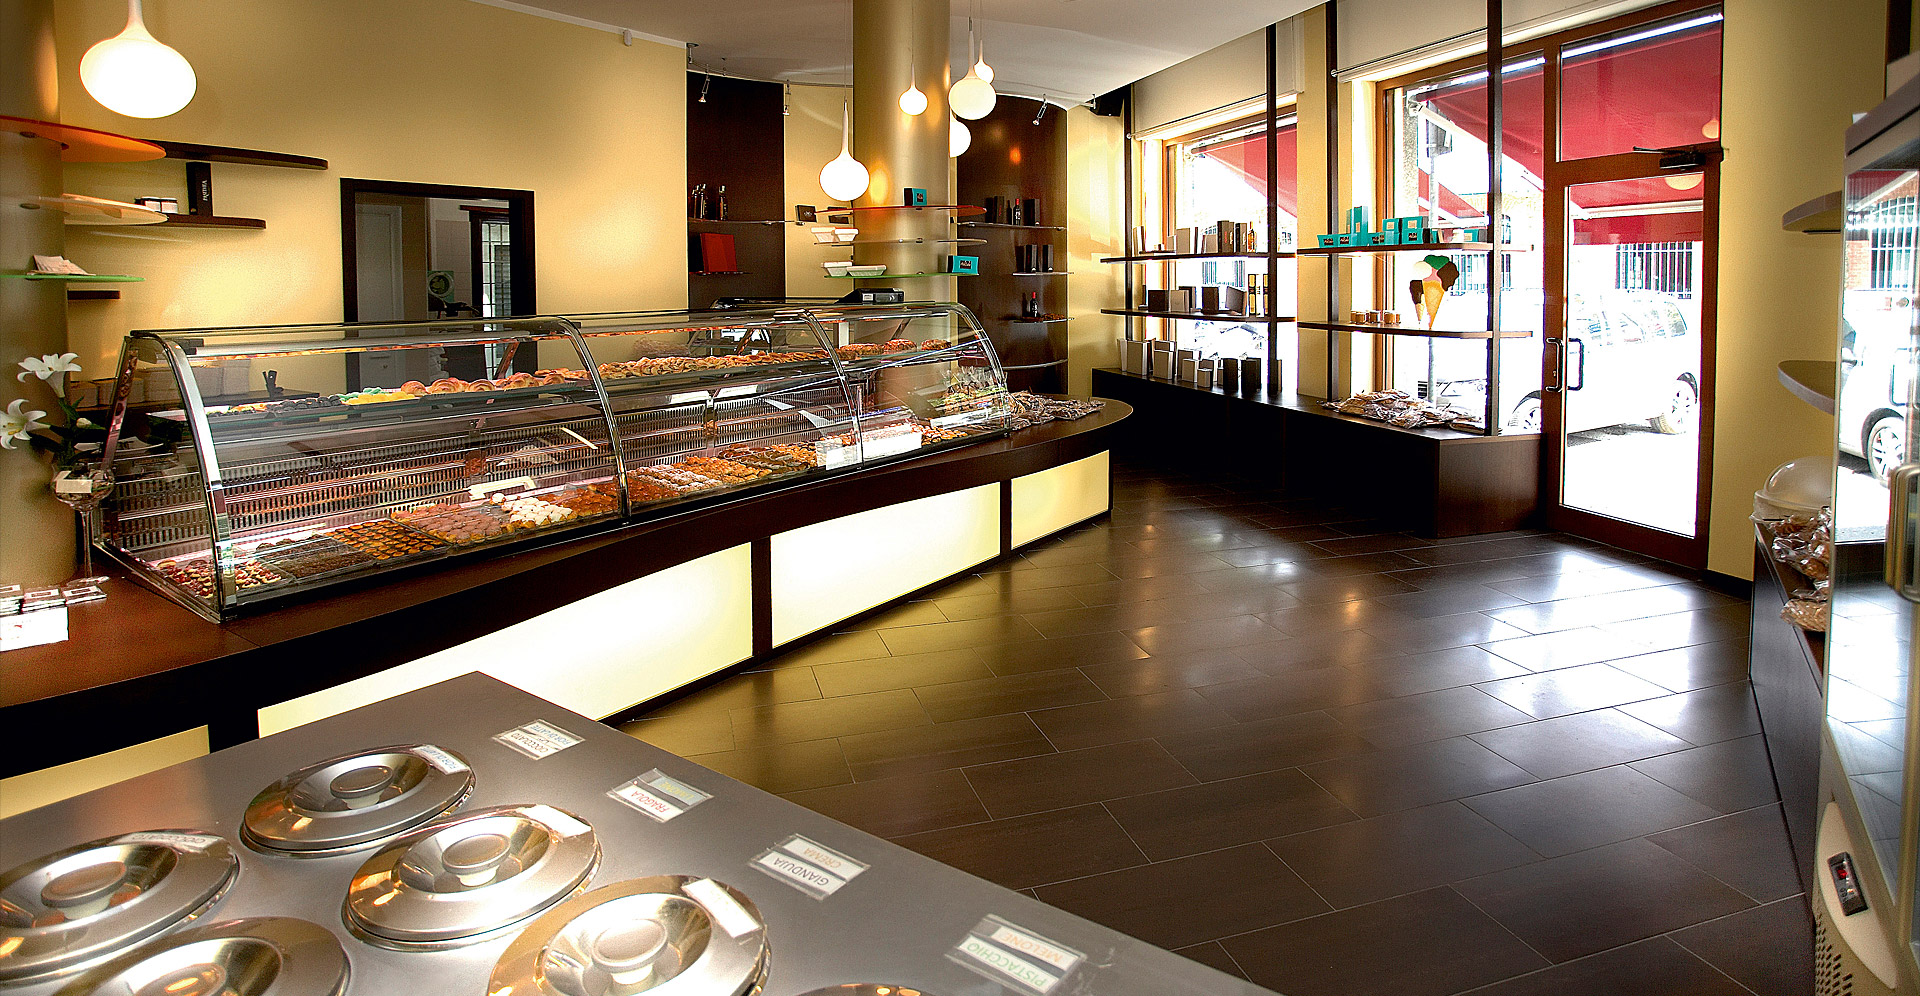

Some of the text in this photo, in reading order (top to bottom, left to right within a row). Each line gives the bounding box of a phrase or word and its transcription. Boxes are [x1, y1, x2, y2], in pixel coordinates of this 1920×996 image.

[631, 790, 670, 813] FRAGOLA
[773, 857, 829, 886] GIANDUJA
[803, 847, 841, 869] CREMA
[1001, 932, 1064, 963] MELONE
[966, 941, 1048, 988] PISTACCHIO
